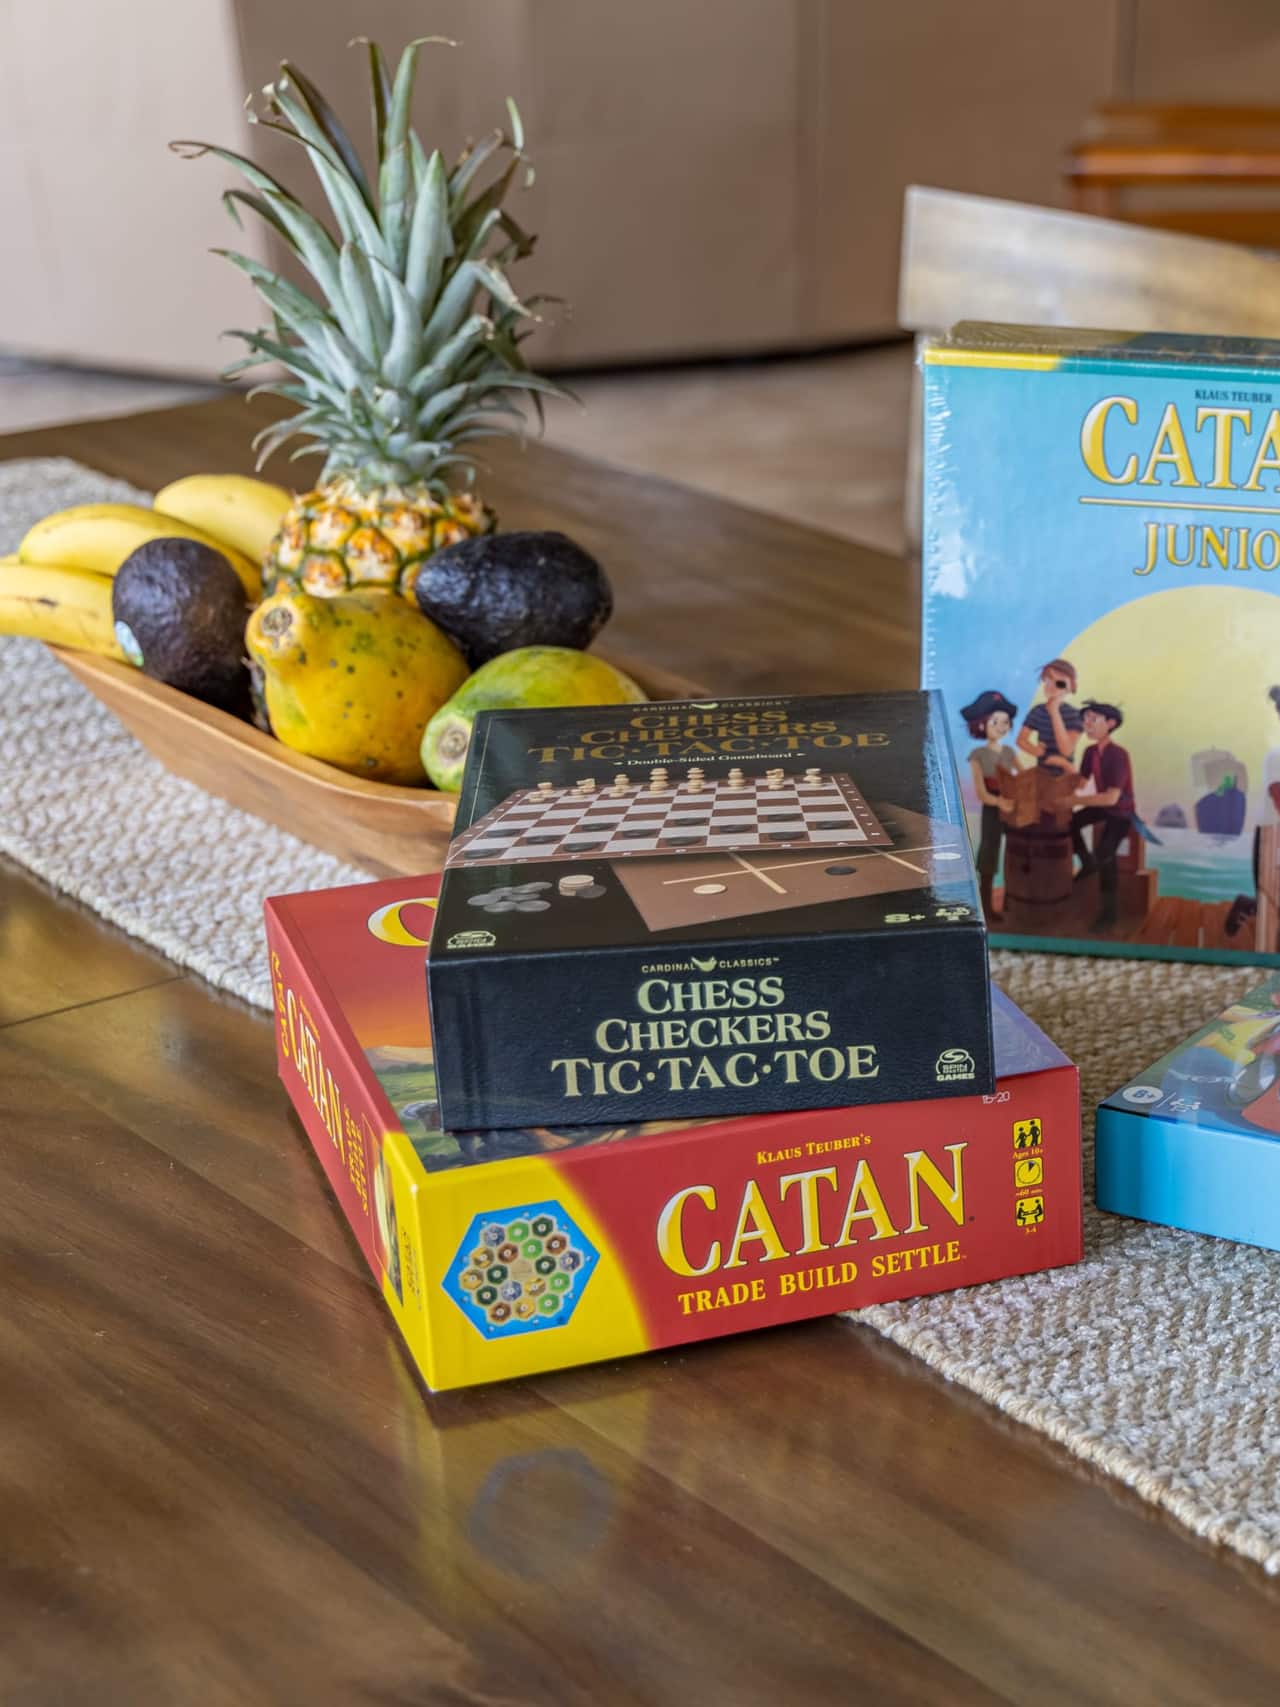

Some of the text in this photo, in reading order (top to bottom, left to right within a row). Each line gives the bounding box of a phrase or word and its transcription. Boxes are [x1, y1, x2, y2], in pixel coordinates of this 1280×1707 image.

[1194, 388, 1273, 404] KLAUS TEUBER
[629, 709, 790, 730] CHESS
[580, 719, 839, 746] CHECKERS
[626, 754, 716, 767] Double-Sided
[641, 963, 696, 974] CARDINAL
[637, 975, 786, 1016] CHESS
[595, 1009, 832, 1055] CHECKERS
[286, 988, 346, 1166] CATAN
[936, 1072, 976, 1082] GAMES
[756, 1146, 802, 1167] KLAUS
[656, 1143, 969, 1277] CATAN
[678, 1240, 962, 1316] TRADE BUILD SETTLE
